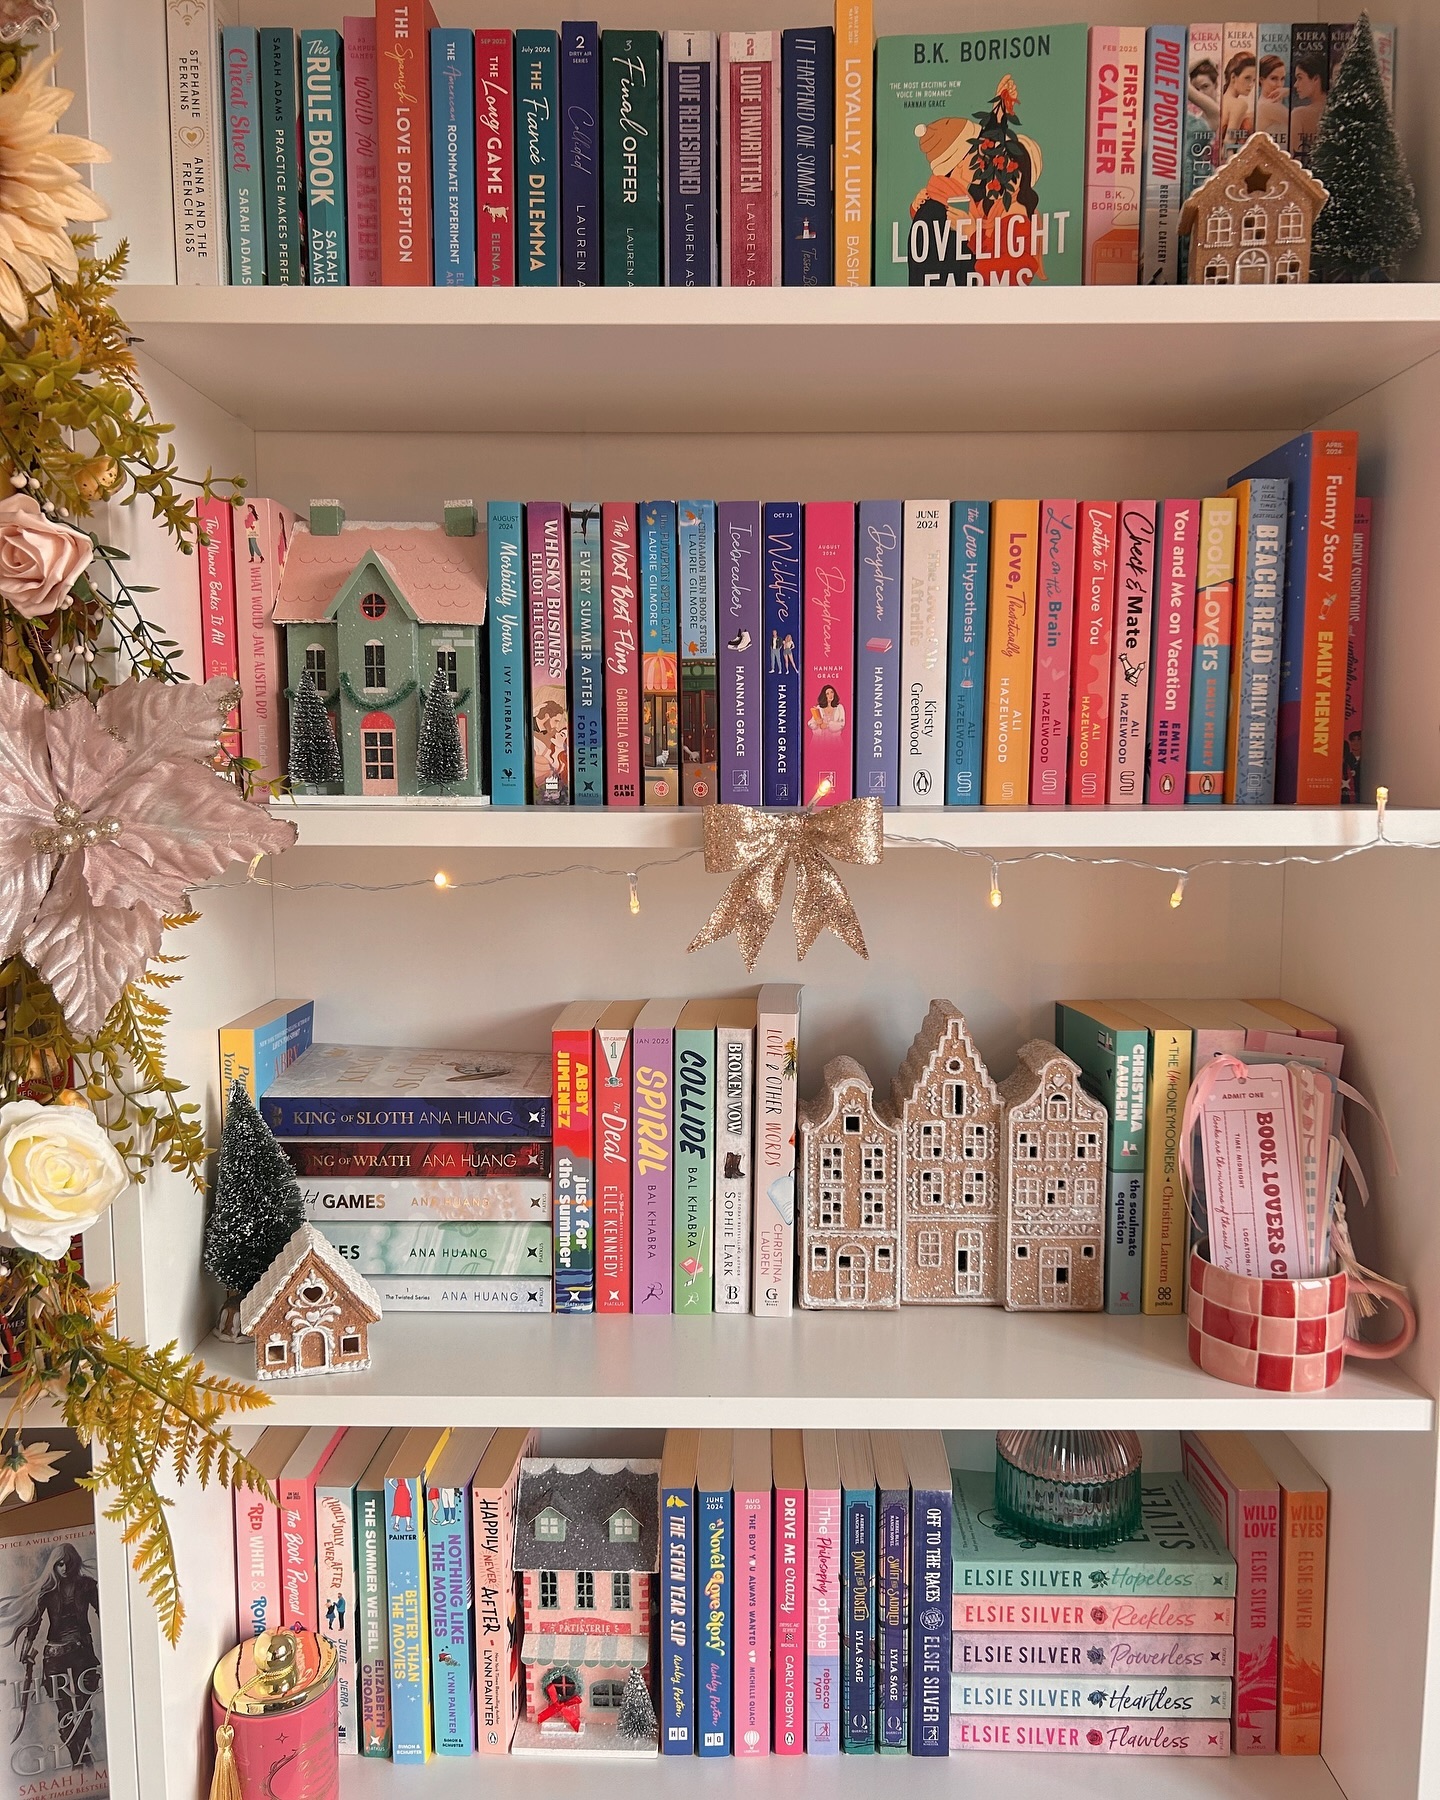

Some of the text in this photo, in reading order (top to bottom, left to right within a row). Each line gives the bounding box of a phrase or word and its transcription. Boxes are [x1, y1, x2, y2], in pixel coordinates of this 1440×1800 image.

[178, 57, 188, 111] PERKINS
[189, 49, 201, 118] STEPHANIE
[914, 35, 1050, 64] B.K. BORISON
[306, 39, 334, 206] The RULE BOOK
[385, 6, 417, 263] THE Spanish LOVE DECEPTION
[480, 56, 508, 194] THE Long GAME
[612, 56, 648, 203] Final OFFER
[679, 66, 700, 195] LOVE REDESIGNED
[740, 66, 762, 193] LOVE UNWRITTEN
[795, 39, 816, 207] IT HAPPENED ONE SUMMER
[842, 59, 861, 158] LOYALLY,
[904, 100, 926, 108] HANNAH
[1096, 64, 1119, 174] CALLER
[1121, 64, 1138, 175] FIRST-TIME
[1152, 38, 1181, 180] POLE POSITION
[182, 162, 195, 253] FRENCH KISS
[194, 157, 207, 258] ANNA AND THE
[523, 61, 549, 271] THE Fiancé DILEMMA
[845, 166, 861, 222] LUKE
[311, 228, 325, 284] ADAMS
[325, 230, 338, 283] SARAH
[892, 211, 1070, 263] LOVELIGHT
[917, 521, 938, 529] 2024
[1318, 475, 1342, 582] Funny Story
[531, 552, 545, 667] ELLIOT FLETCHER
[543, 519, 562, 679] WHISKY BUSINESS
[648, 530, 658, 626] LAURIE GILMORE
[1164, 508, 1189, 711] You and Me on Vacation
[1202, 510, 1232, 672] Book Lovers
[579, 551, 593, 707] EVERY SUMMER AFTER
[1248, 524, 1279, 768] BEACH READ EMILY HENRY
[736, 666, 745, 757] HANNAH GRACE
[910, 682, 924, 756] Greenwood
[924, 700, 937, 737] Kirsty
[998, 677, 1009, 763] HAZELWOOD
[1012, 710, 1021, 731] ALI
[1313, 631, 1334, 758] EMILY HENRY
[293, 1110, 513, 1125] KING OF SLOTH ANA HUANG
[557, 1050, 571, 1128] JIMENEZ
[575, 1063, 590, 1116] ABBY
[635, 1065, 669, 1176] SPIRAL
[679, 1050, 707, 1160] COLLIDE
[726, 1042, 743, 1135] BROKEN VOW
[1115, 1055, 1128, 1121] LAUREN
[1130, 1044, 1145, 1133] CHRISTINA
[323, 1194, 385, 1209] GAMES
[558, 1157, 573, 1268] the summer
[573, 1169, 590, 1249] just for
[687, 1167, 697, 1249] BAL KHABRA
[1117, 1192, 1126, 1245] equation
[1128, 1179, 1140, 1257] the soulmate
[1257, 1112, 1285, 1255] BOOK LOVERS
[409, 1248, 488, 1258] ANA HUANG
[603, 1185, 618, 1278] ELLE KENNEDY
[723, 1191, 735, 1277] SOPHIE LARK
[784, 1498, 796, 1539] DRIVE
[784, 1544, 796, 1564] ME
[926, 1508, 941, 1602] OFF TO THE RACES
[1243, 1506, 1277, 1519] WILD
[1244, 1523, 1277, 1538] LOVE
[363, 1499, 379, 1653] THE SUMMER WE FELL
[431, 1541, 447, 1638] THE MOVIES
[448, 1534, 464, 1644] NOTHING LIKE
[670, 1516, 686, 1646] THE SEVEN YEAR SLIP
[964, 1567, 1193, 1588] ELSIE SILVER Hopeless
[965, 1604, 1195, 1628] ELSIE SILVER Reckless
[963, 1643, 1202, 1667] ELSIE SILVER Powerless
[963, 1686, 1192, 1711] ELSIE SILVER Heartless
[960, 1721, 1189, 1749] ELSIE SILVER Flawless
